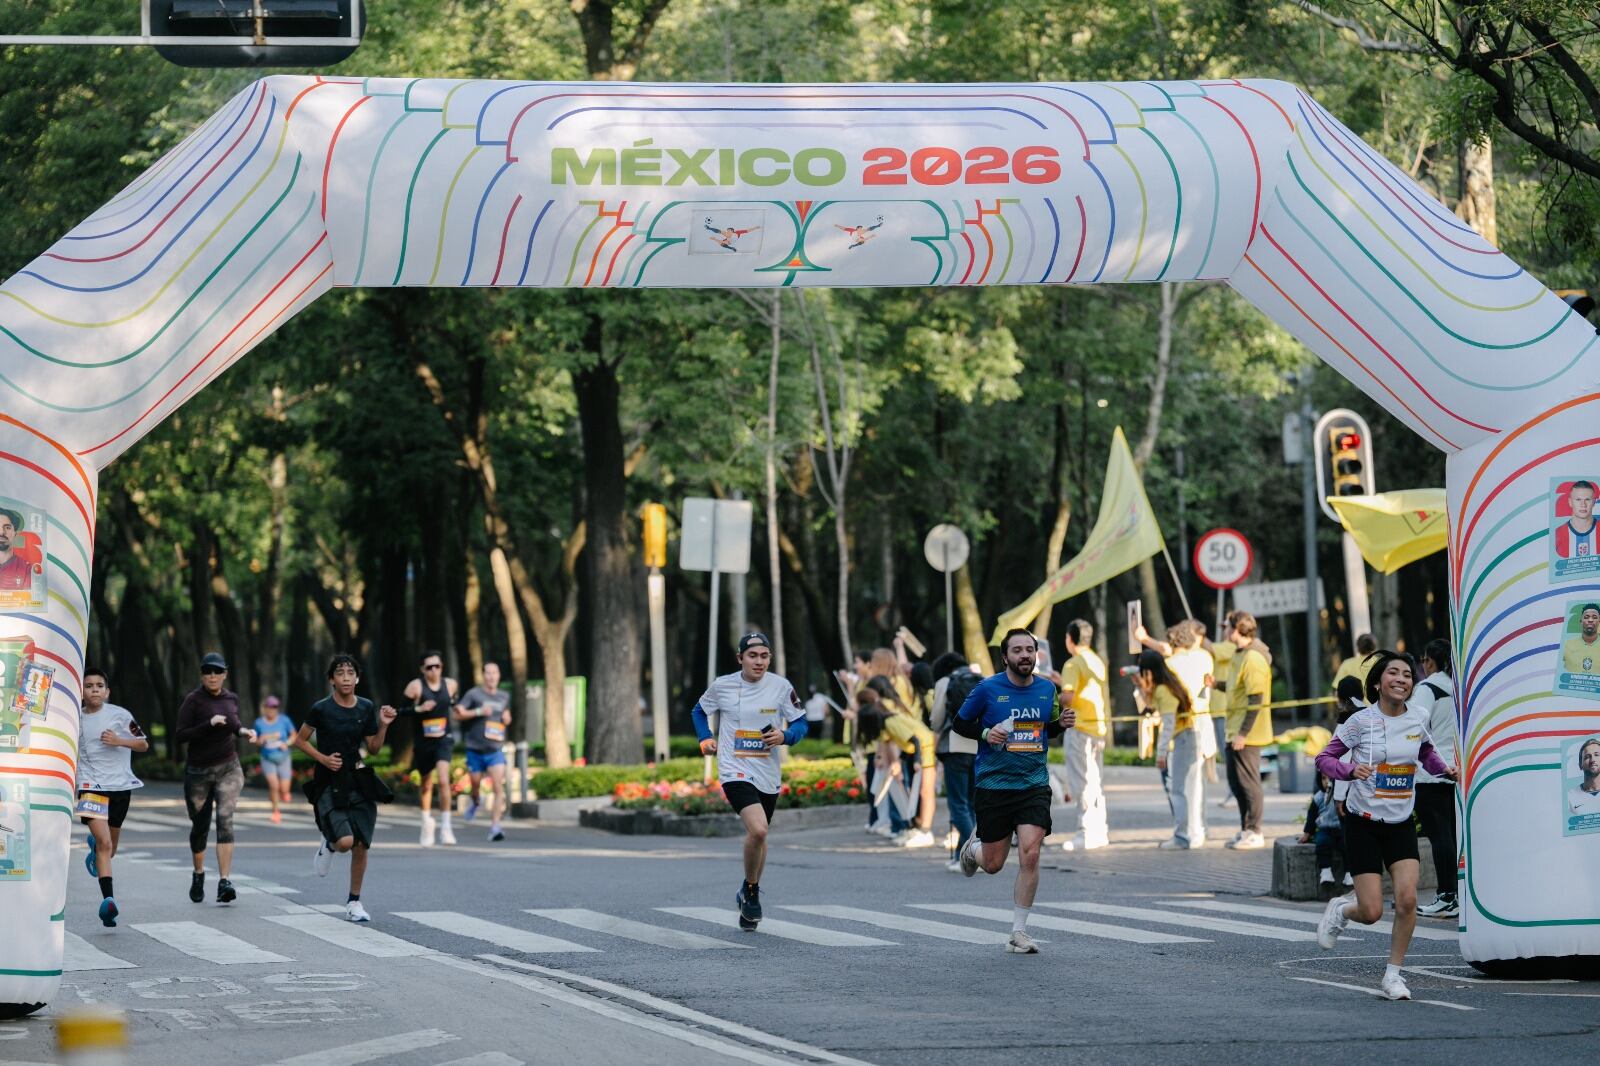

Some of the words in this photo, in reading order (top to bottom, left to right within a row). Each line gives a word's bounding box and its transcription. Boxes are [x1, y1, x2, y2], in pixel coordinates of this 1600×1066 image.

[550, 137, 847, 186] MÉXICO
[862, 146, 1061, 186] 2026
[1210, 541, 1236, 562] 50
[1011, 707, 1041, 719] DAN
[1013, 732, 1034, 740] 1979
[1386, 777, 1407, 787] 1062
[83, 802, 101, 812] 4291
